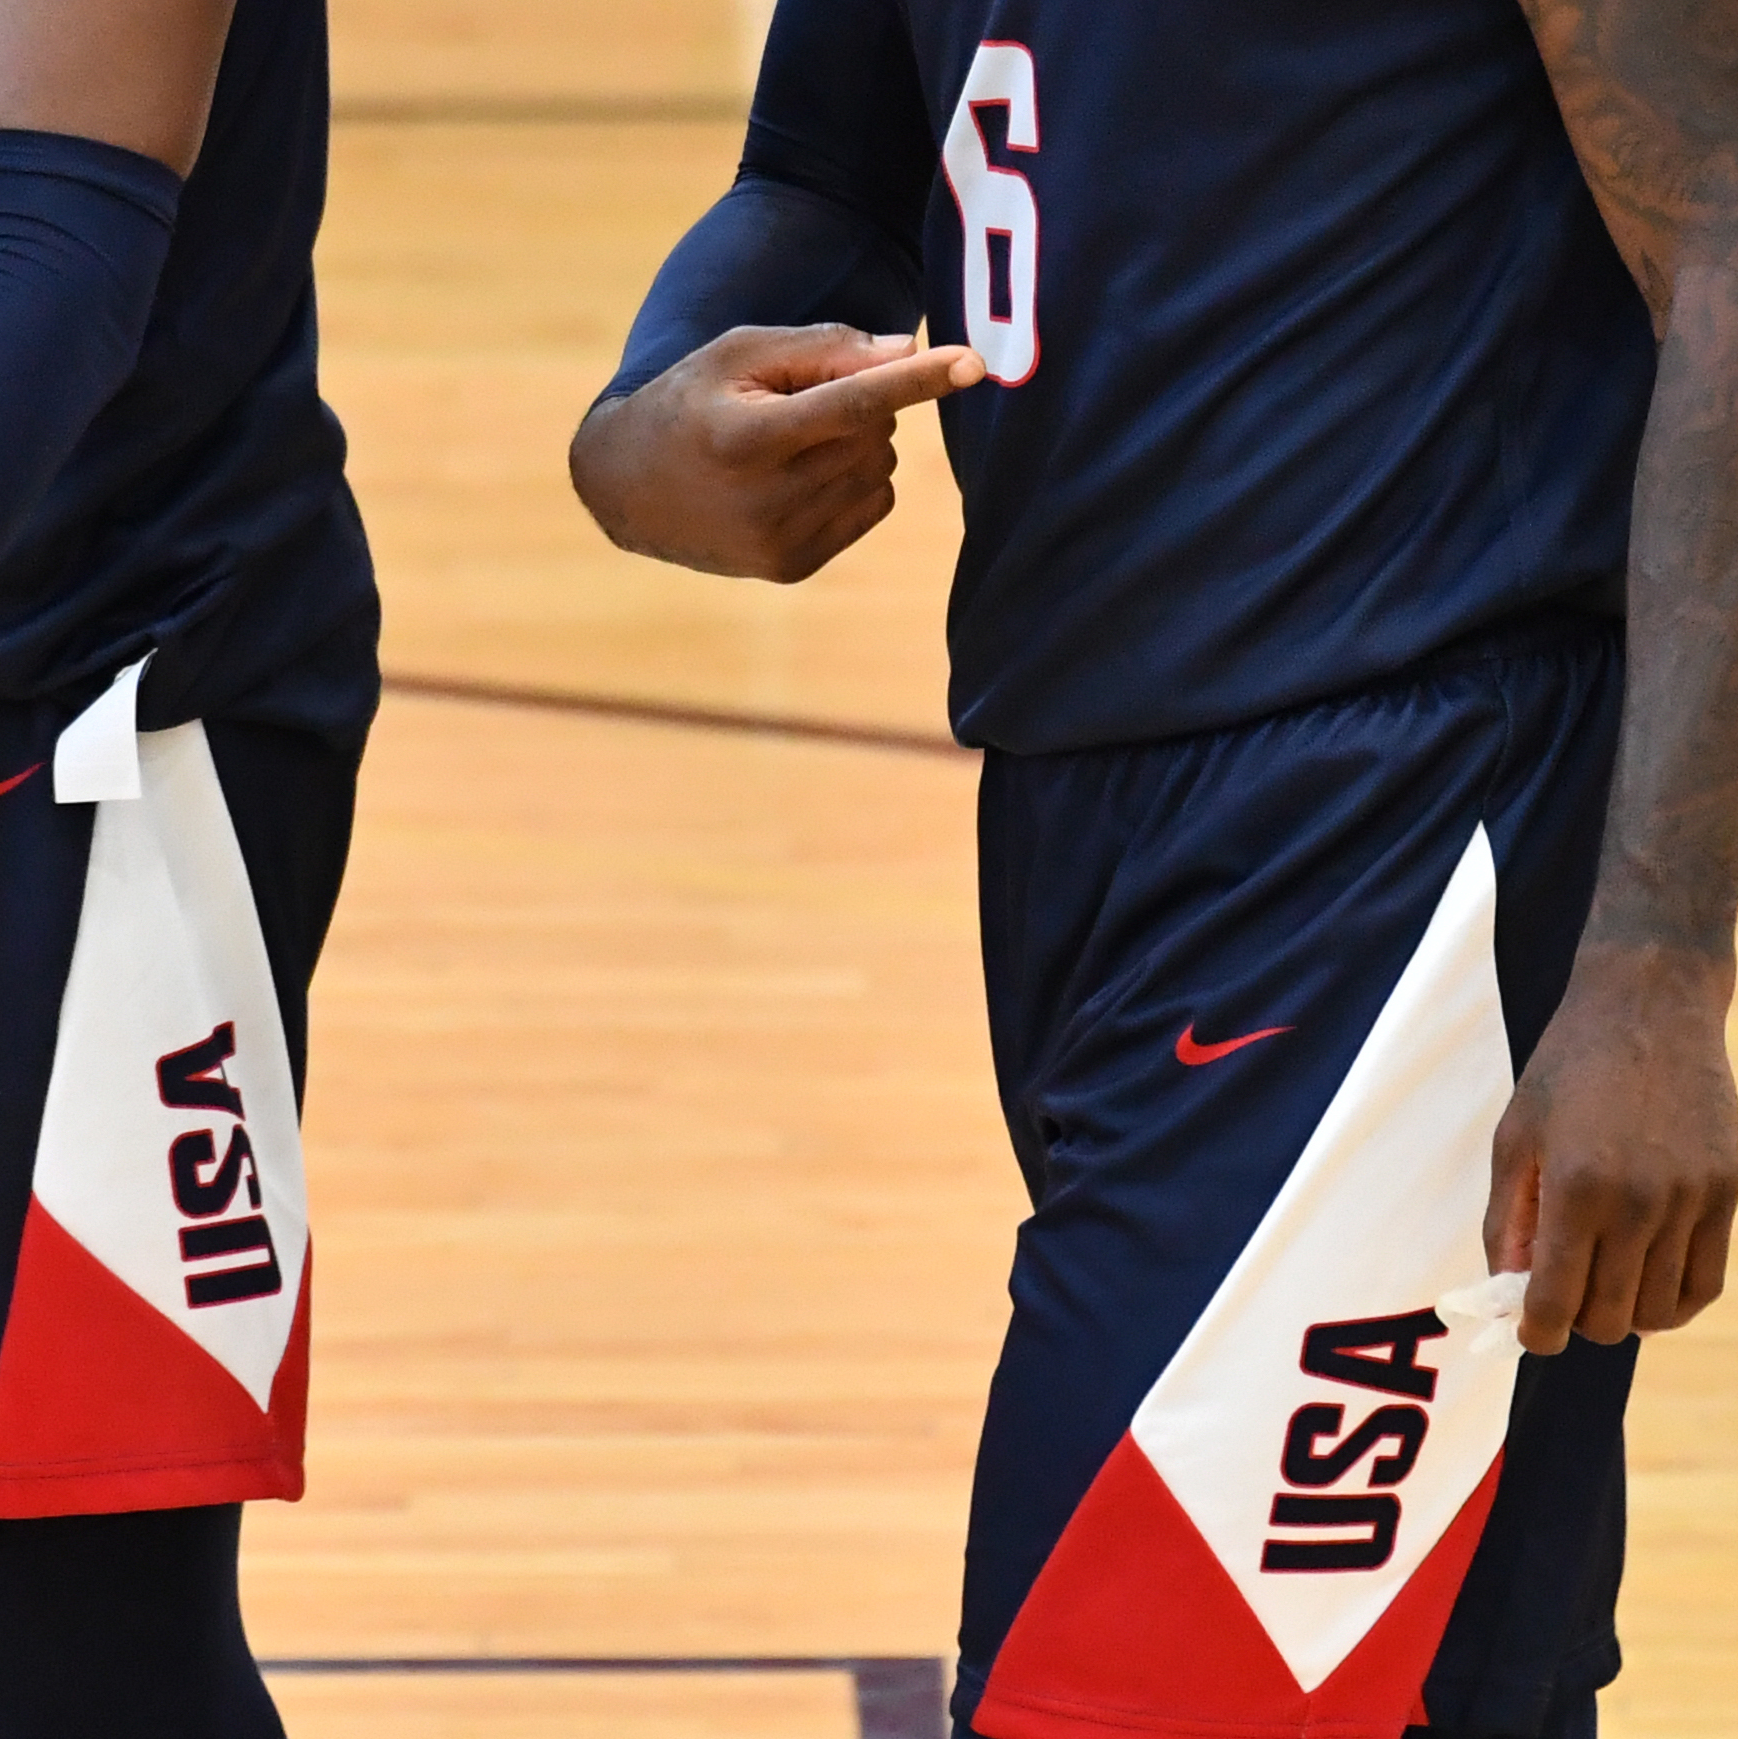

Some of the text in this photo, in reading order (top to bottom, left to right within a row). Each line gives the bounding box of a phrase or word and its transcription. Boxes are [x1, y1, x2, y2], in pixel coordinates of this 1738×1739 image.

[942, 40, 1041, 387] 6
[155, 1021, 283, 1309] USA
[1260, 1305, 1449, 1573] USA
